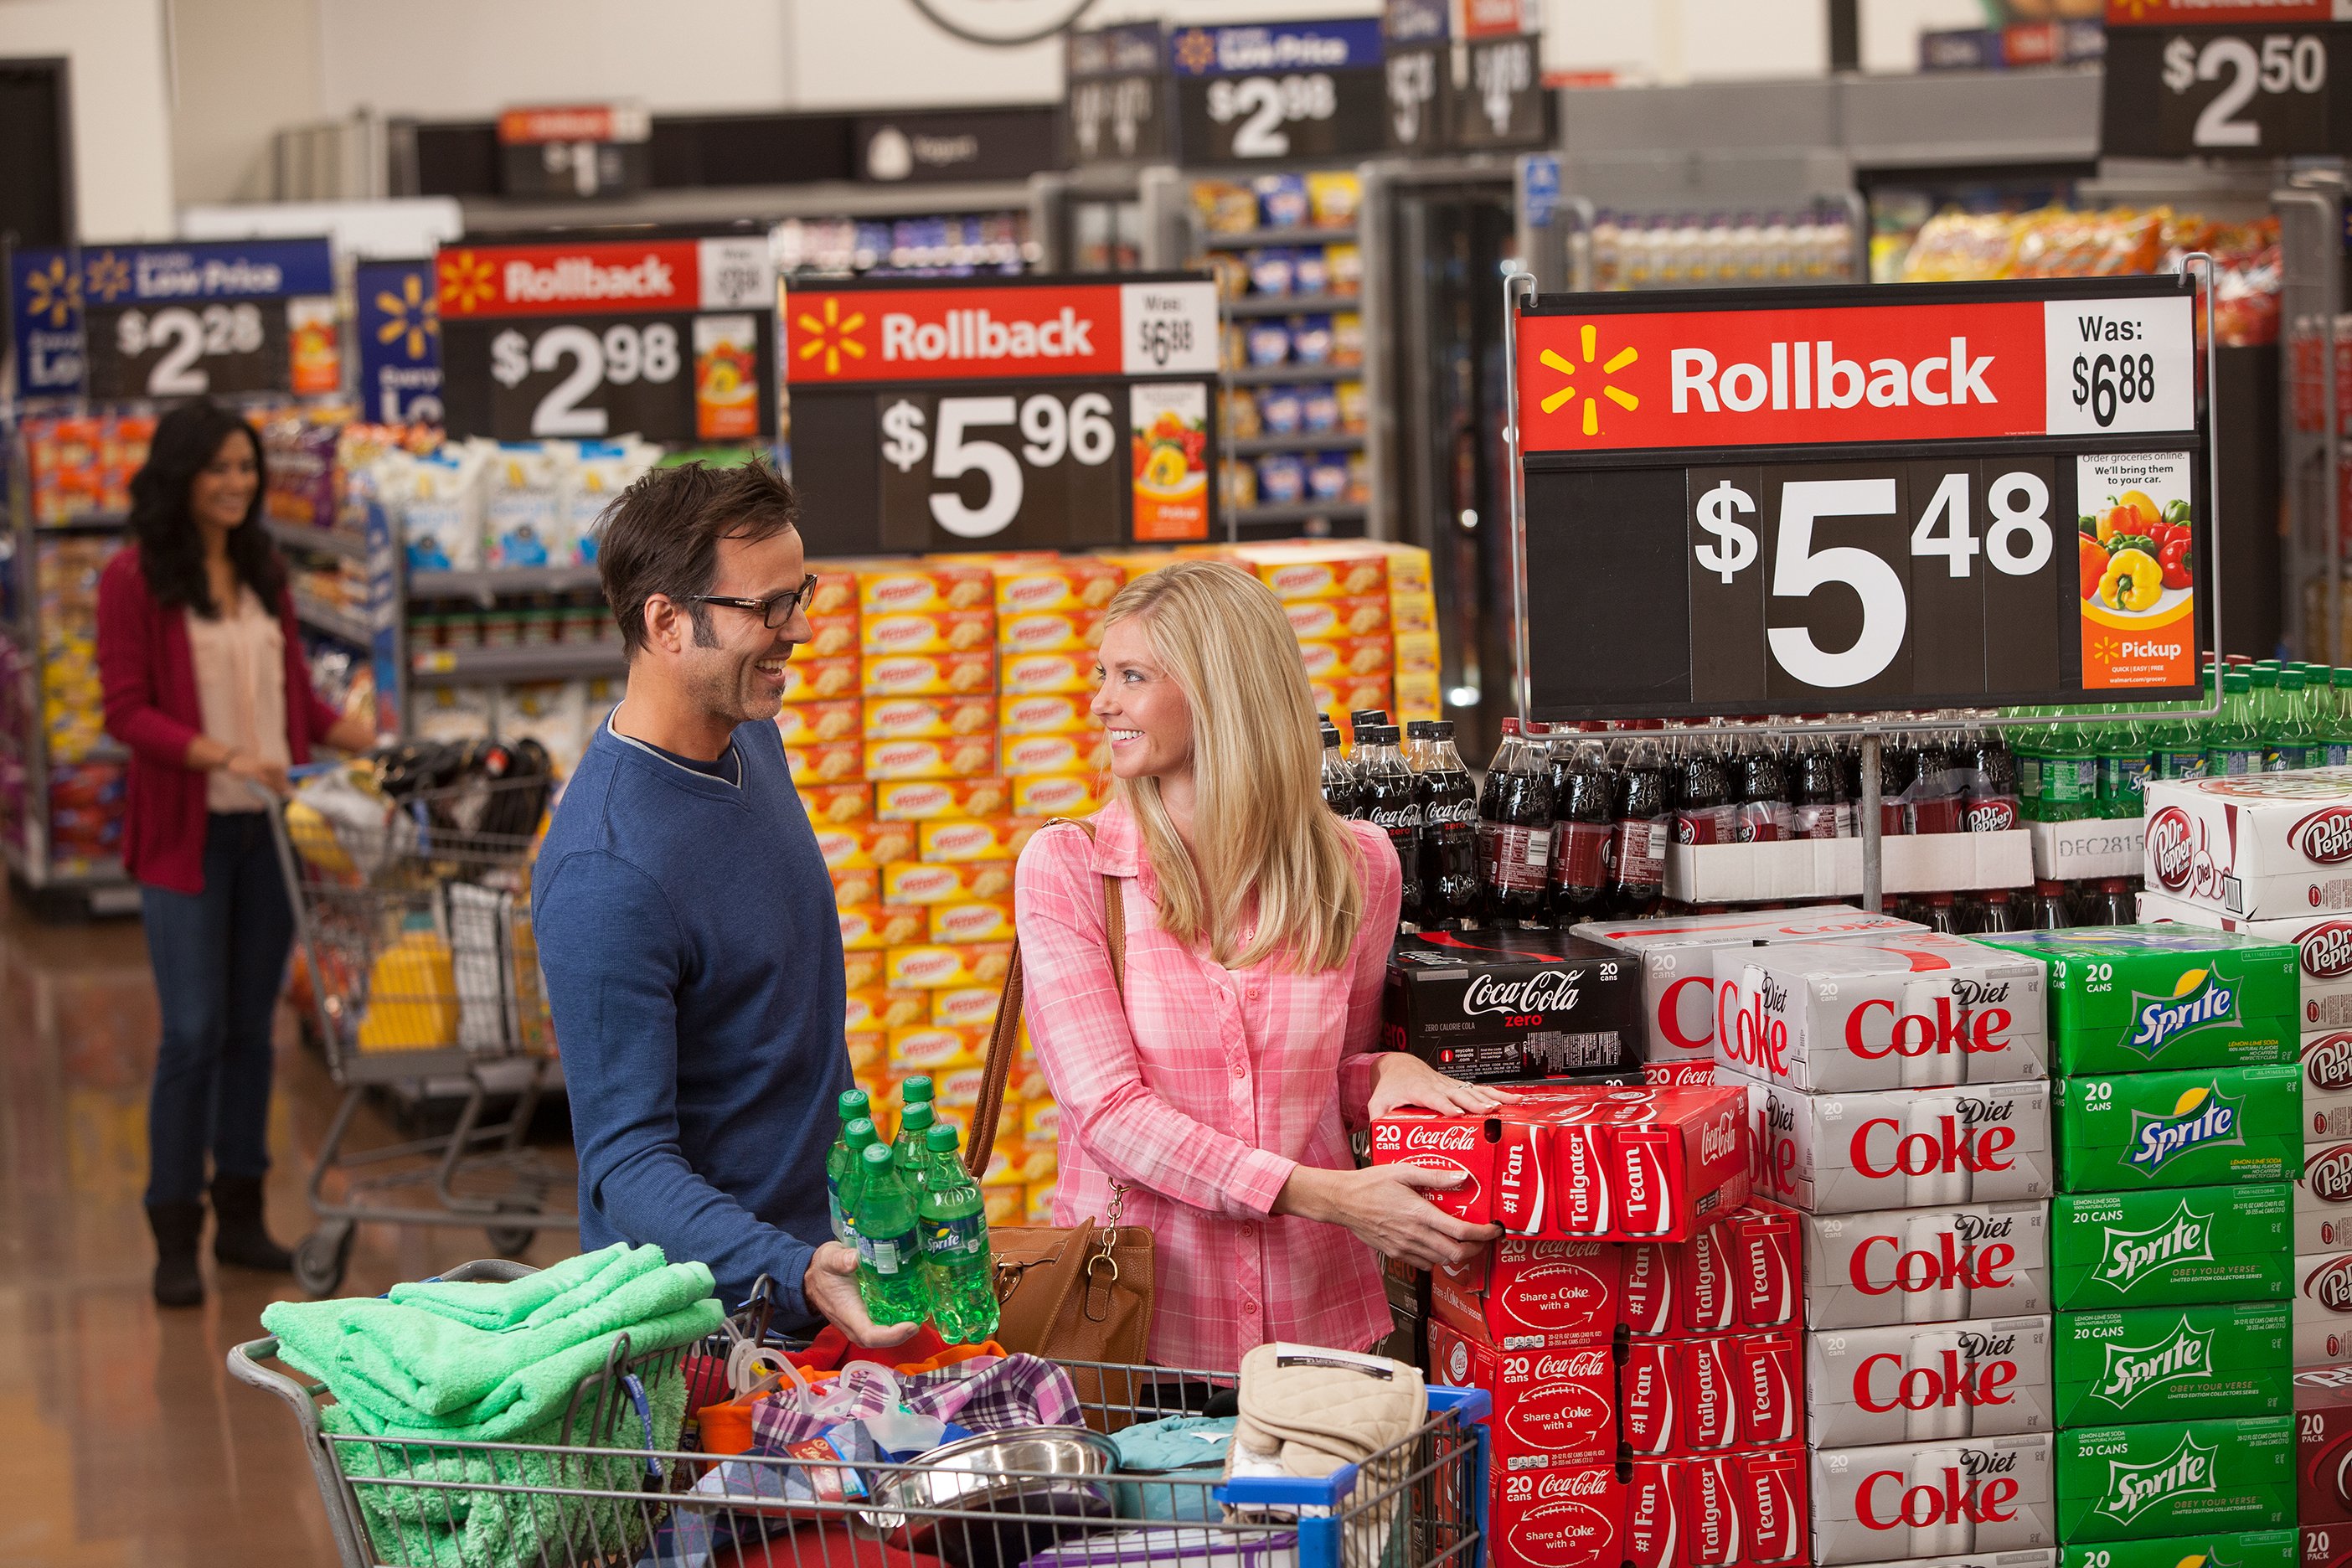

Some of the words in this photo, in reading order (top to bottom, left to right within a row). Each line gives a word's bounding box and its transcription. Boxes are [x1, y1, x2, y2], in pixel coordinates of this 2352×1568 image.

[504, 255, 674, 303] Rollback
[881, 307, 1095, 362] Rollback
[2078, 316, 2143, 342] Was:
[1671, 337, 1999, 415] Rollback
[2111, 453, 2153, 463] groceries
[2120, 466, 2146, 475] bring
[2148, 465, 2174, 473] them
[2120, 477, 2142, 486] your
[2122, 641, 2181, 660] Pickup
[1981, 805, 2001, 822] Dr
[1390, 828, 1412, 836] zero
[1445, 822, 1466, 830] zero
[2169, 818, 2184, 848] Dr
[2155, 823, 2193, 879] Pepper
[2196, 864, 2210, 885] Diet
[1600, 962, 1617, 976] 20
[1652, 955, 1676, 970] 20
[1653, 969, 1676, 979] cans
[2053, 961, 2066, 978] 20
[2086, 964, 2112, 982] 20
[1463, 969, 1586, 1016] Coca-Cola
[1762, 977, 1787, 1013] Diet
[1819, 983, 1839, 995] 20
[1952, 979, 2010, 1006] Diet
[2086, 983, 2112, 993] CANS
[1504, 1014, 1542, 1028] zero
[2132, 977, 2231, 1053] Sprite
[1425, 1024, 1439, 1032] ZERO
[1440, 1023, 1461, 1031] CALORIE
[1462, 1022, 1475, 1030] COLA
[1718, 980, 1789, 1078] Coke
[1844, 997, 2011, 1060] Coke
[1647, 1068, 1670, 1085] 20
[2085, 1083, 2112, 1101] 20
[1766, 1095, 1795, 1132] Diet
[1956, 1098, 2014, 1124] Diet
[2086, 1102, 2111, 1112] CANS
[1376, 1125, 1401, 1142] 20
[1406, 1126, 1478, 1151] Coca-Cola
[1701, 1109, 1736, 1166] Coca-Cola
[2132, 1097, 2231, 1166] Sprite
[1376, 1141, 1400, 1150] cans
[1849, 1115, 2015, 1179] Coke
[1502, 1143, 1524, 1189] Fan
[1571, 1132, 1590, 1226] Tailgater
[1627, 1146, 1647, 1218] Team
[1503, 1191, 1519, 1214] #1
[1824, 1220, 1843, 1232] 20
[1955, 1215, 2012, 1240] Diet
[2073, 1213, 2089, 1223] 20
[2092, 1210, 2123, 1222] CANS
[927, 1234, 960, 1254] Sprite
[1532, 1240, 1601, 1260] Coca-Cola
[2106, 1216, 2201, 1281] Sprite
[1501, 1254, 1526, 1262] cans
[1629, 1247, 1650, 1290] Fan
[1850, 1232, 2015, 1295] Coke
[1697, 1233, 1715, 1323] Tailgater
[1749, 1240, 1767, 1310] Team
[2172, 1268, 2197, 1277] OBEY
[2200, 1266, 2225, 1275] YOUR
[1519, 1292, 1548, 1302] Share
[1559, 1287, 1589, 1300] Coke
[1540, 1302, 1561, 1310] with
[1629, 1295, 1643, 1315] #1
[2075, 1329, 2090, 1339] 20
[2092, 1326, 2124, 1338] CANS
[1958, 1333, 2015, 1358] Diet
[1504, 1358, 1529, 1375] 20
[1534, 1351, 1607, 1380] Coca-Cola
[2104, 1332, 2201, 1397] Sprite
[1504, 1374, 1529, 1382] cans
[1631, 1365, 1652, 1407] Fan
[1853, 1349, 2017, 1412] Coke
[1698, 1350, 1717, 1442] Tailgater
[1753, 1356, 1772, 1426] Team
[1632, 1410, 1646, 1434] #1
[2301, 1414, 2324, 1436] 20
[2078, 1446, 2094, 1457] 20
[2096, 1443, 2128, 1455] CANS
[2302, 1435, 2324, 1443] PACK
[1961, 1450, 2017, 1475] Diet
[1507, 1476, 1532, 1493] 20
[1538, 1470, 1611, 1498] Coca-Cola
[2109, 1449, 2205, 1514] Sprite
[1507, 1492, 1532, 1501] cans
[1635, 1483, 1656, 1528] Fan
[1855, 1467, 2019, 1530] Coke
[1702, 1467, 1721, 1560] Tailgater
[1757, 1474, 1776, 1546] Team
[1635, 1529, 1649, 1554] #1
[2307, 1531, 2329, 1553] 20
[2085, 1550, 2111, 1568] 20
[2308, 1552, 2329, 1560] PACK
